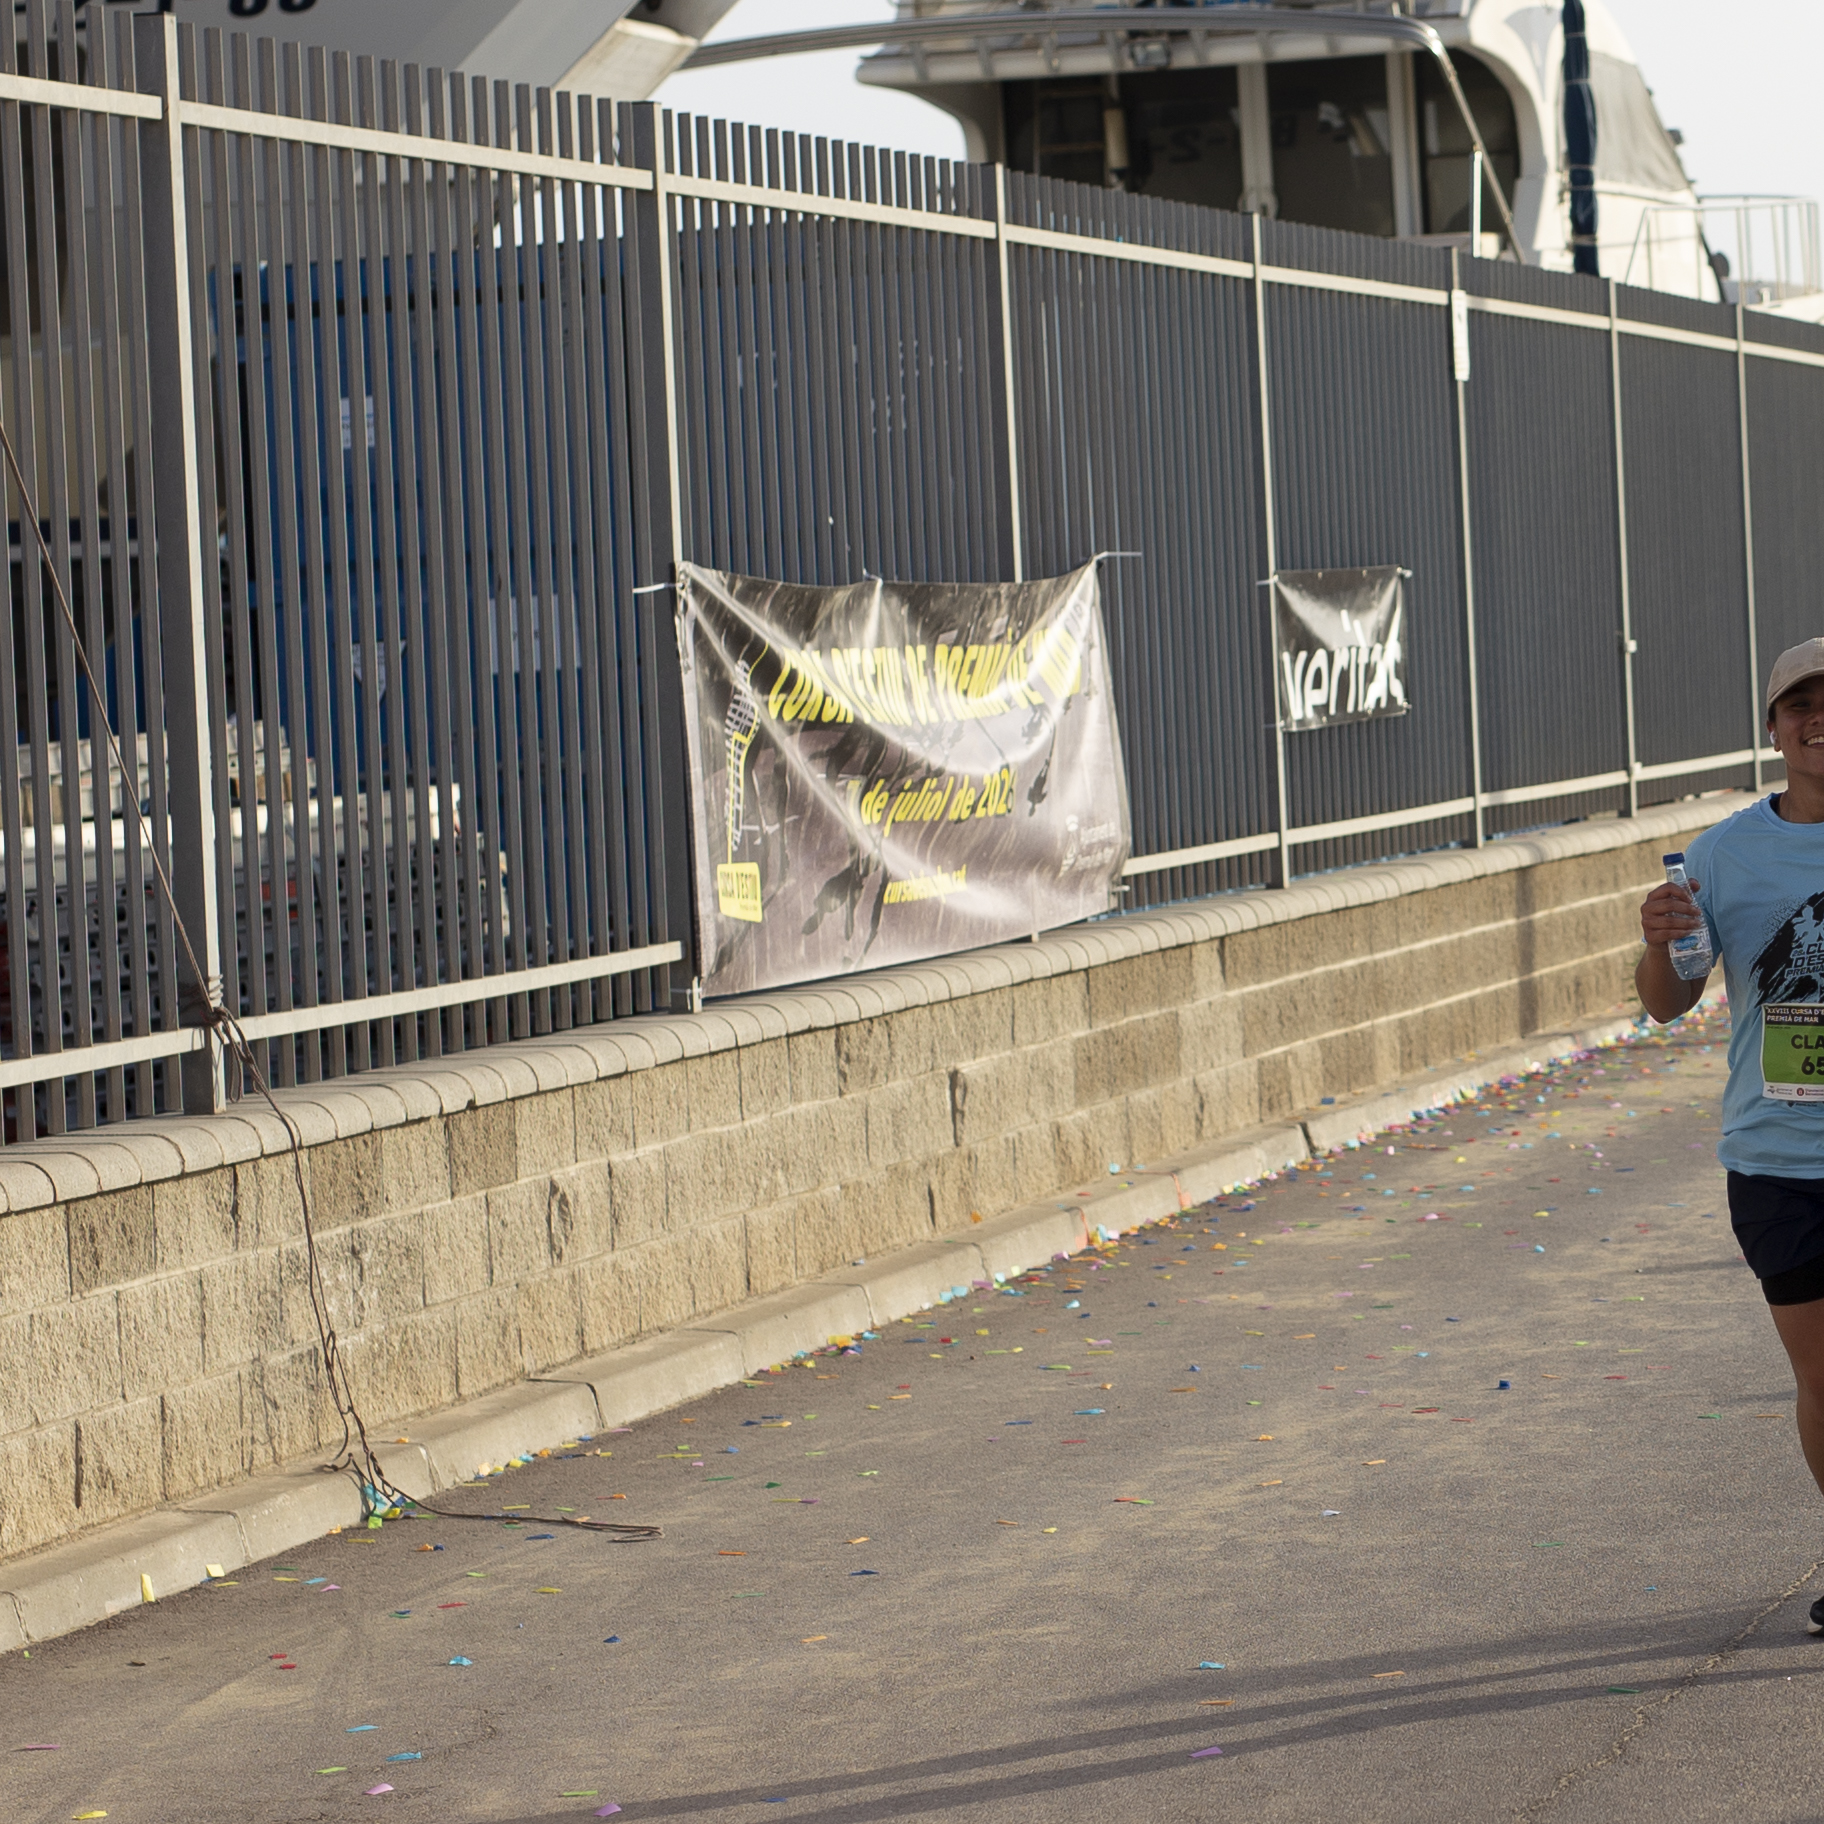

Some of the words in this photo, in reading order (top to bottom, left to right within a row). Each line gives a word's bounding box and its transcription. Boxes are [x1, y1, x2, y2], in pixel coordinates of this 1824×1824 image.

[861, 779, 889, 825] de
[884, 776, 955, 838] juliol
[949, 774, 976, 821] de
